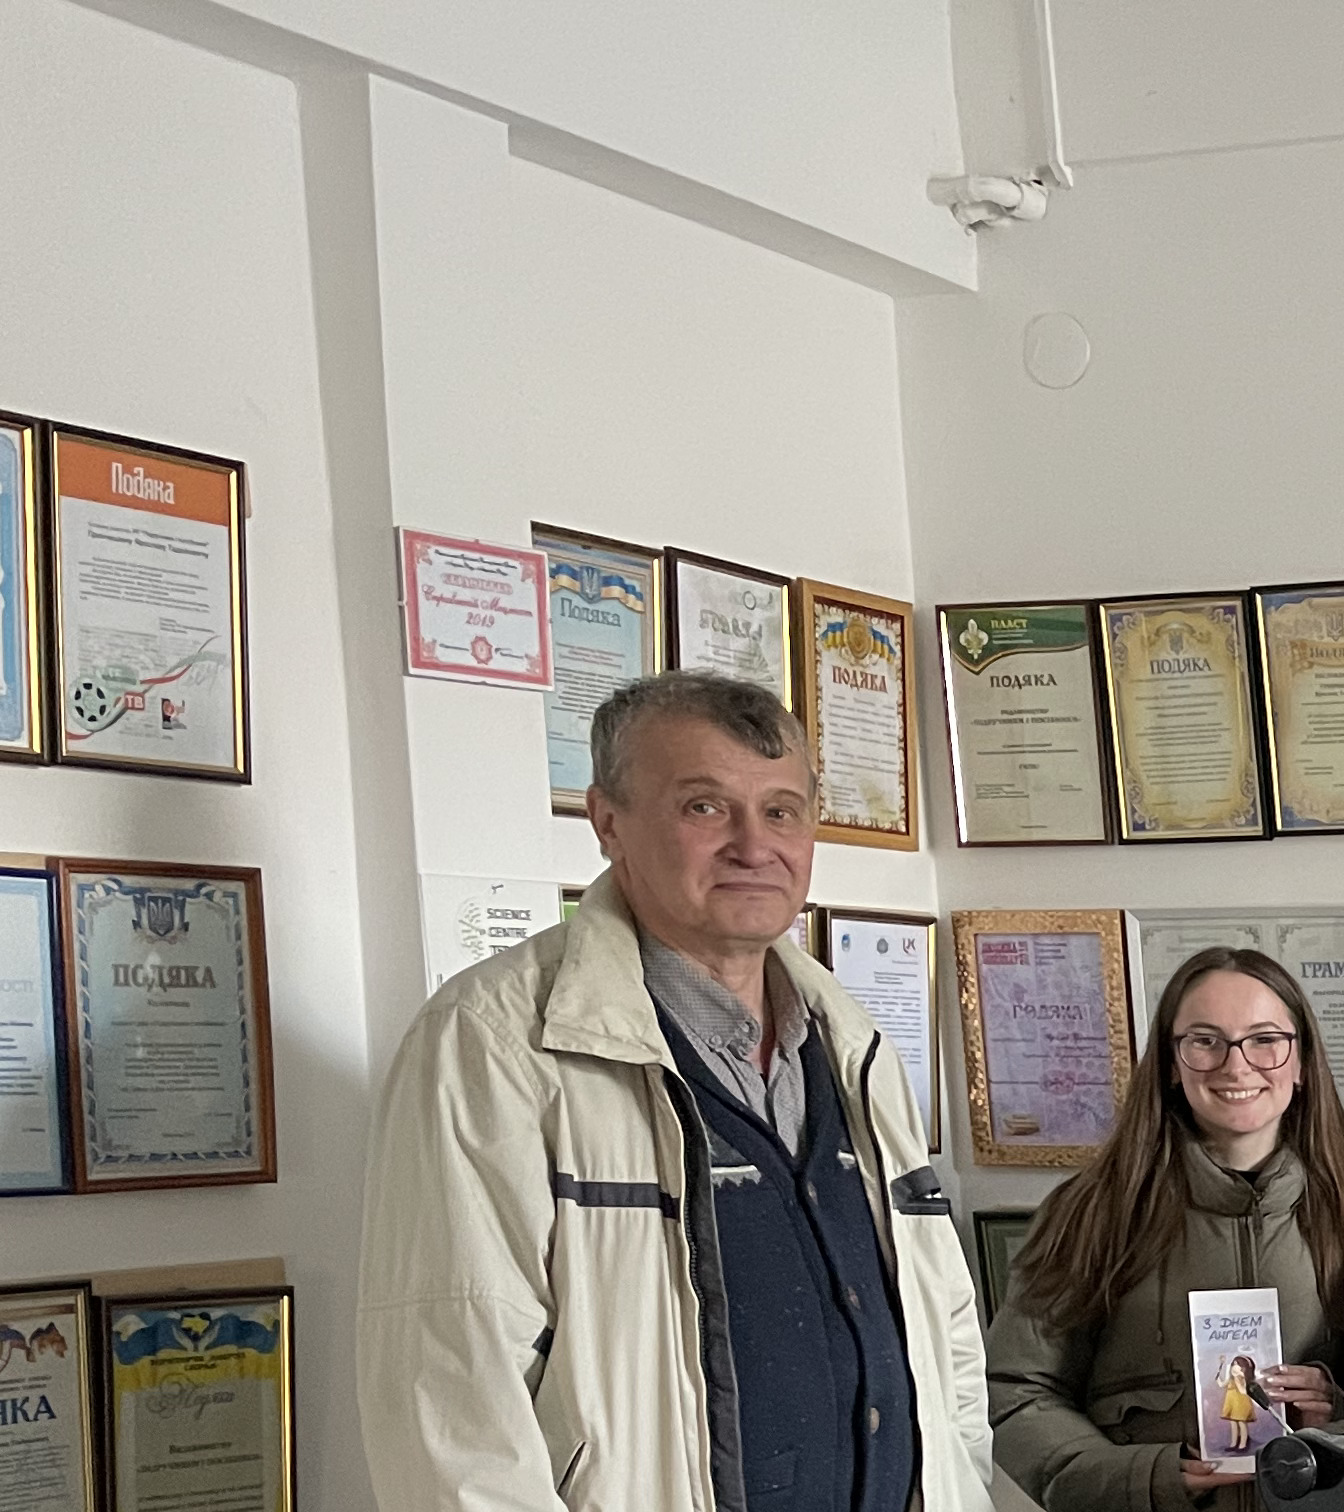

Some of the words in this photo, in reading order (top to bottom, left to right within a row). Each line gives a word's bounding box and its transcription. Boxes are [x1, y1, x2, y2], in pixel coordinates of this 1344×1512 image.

[112, 461, 175, 505] Подяка
[465, 611, 496, 628] 2019
[560, 597, 622, 627] Подяка
[990, 619, 1028, 629] ПЛАСТ
[1150, 657, 1212, 676] ПОДЯКА
[832, 664, 889, 694] ПОДЯКА
[990, 673, 1058, 690] ПОДЯКА
[487, 908, 532, 921] SCIENCE
[488, 926, 528, 939] CENTRE
[111, 962, 217, 993] ПОДЯКА
[1203, 1317, 1212, 1330] З
[1220, 1315, 1262, 1328] ДНЕМ
[1208, 1328, 1258, 1342] АНГЕЛА
